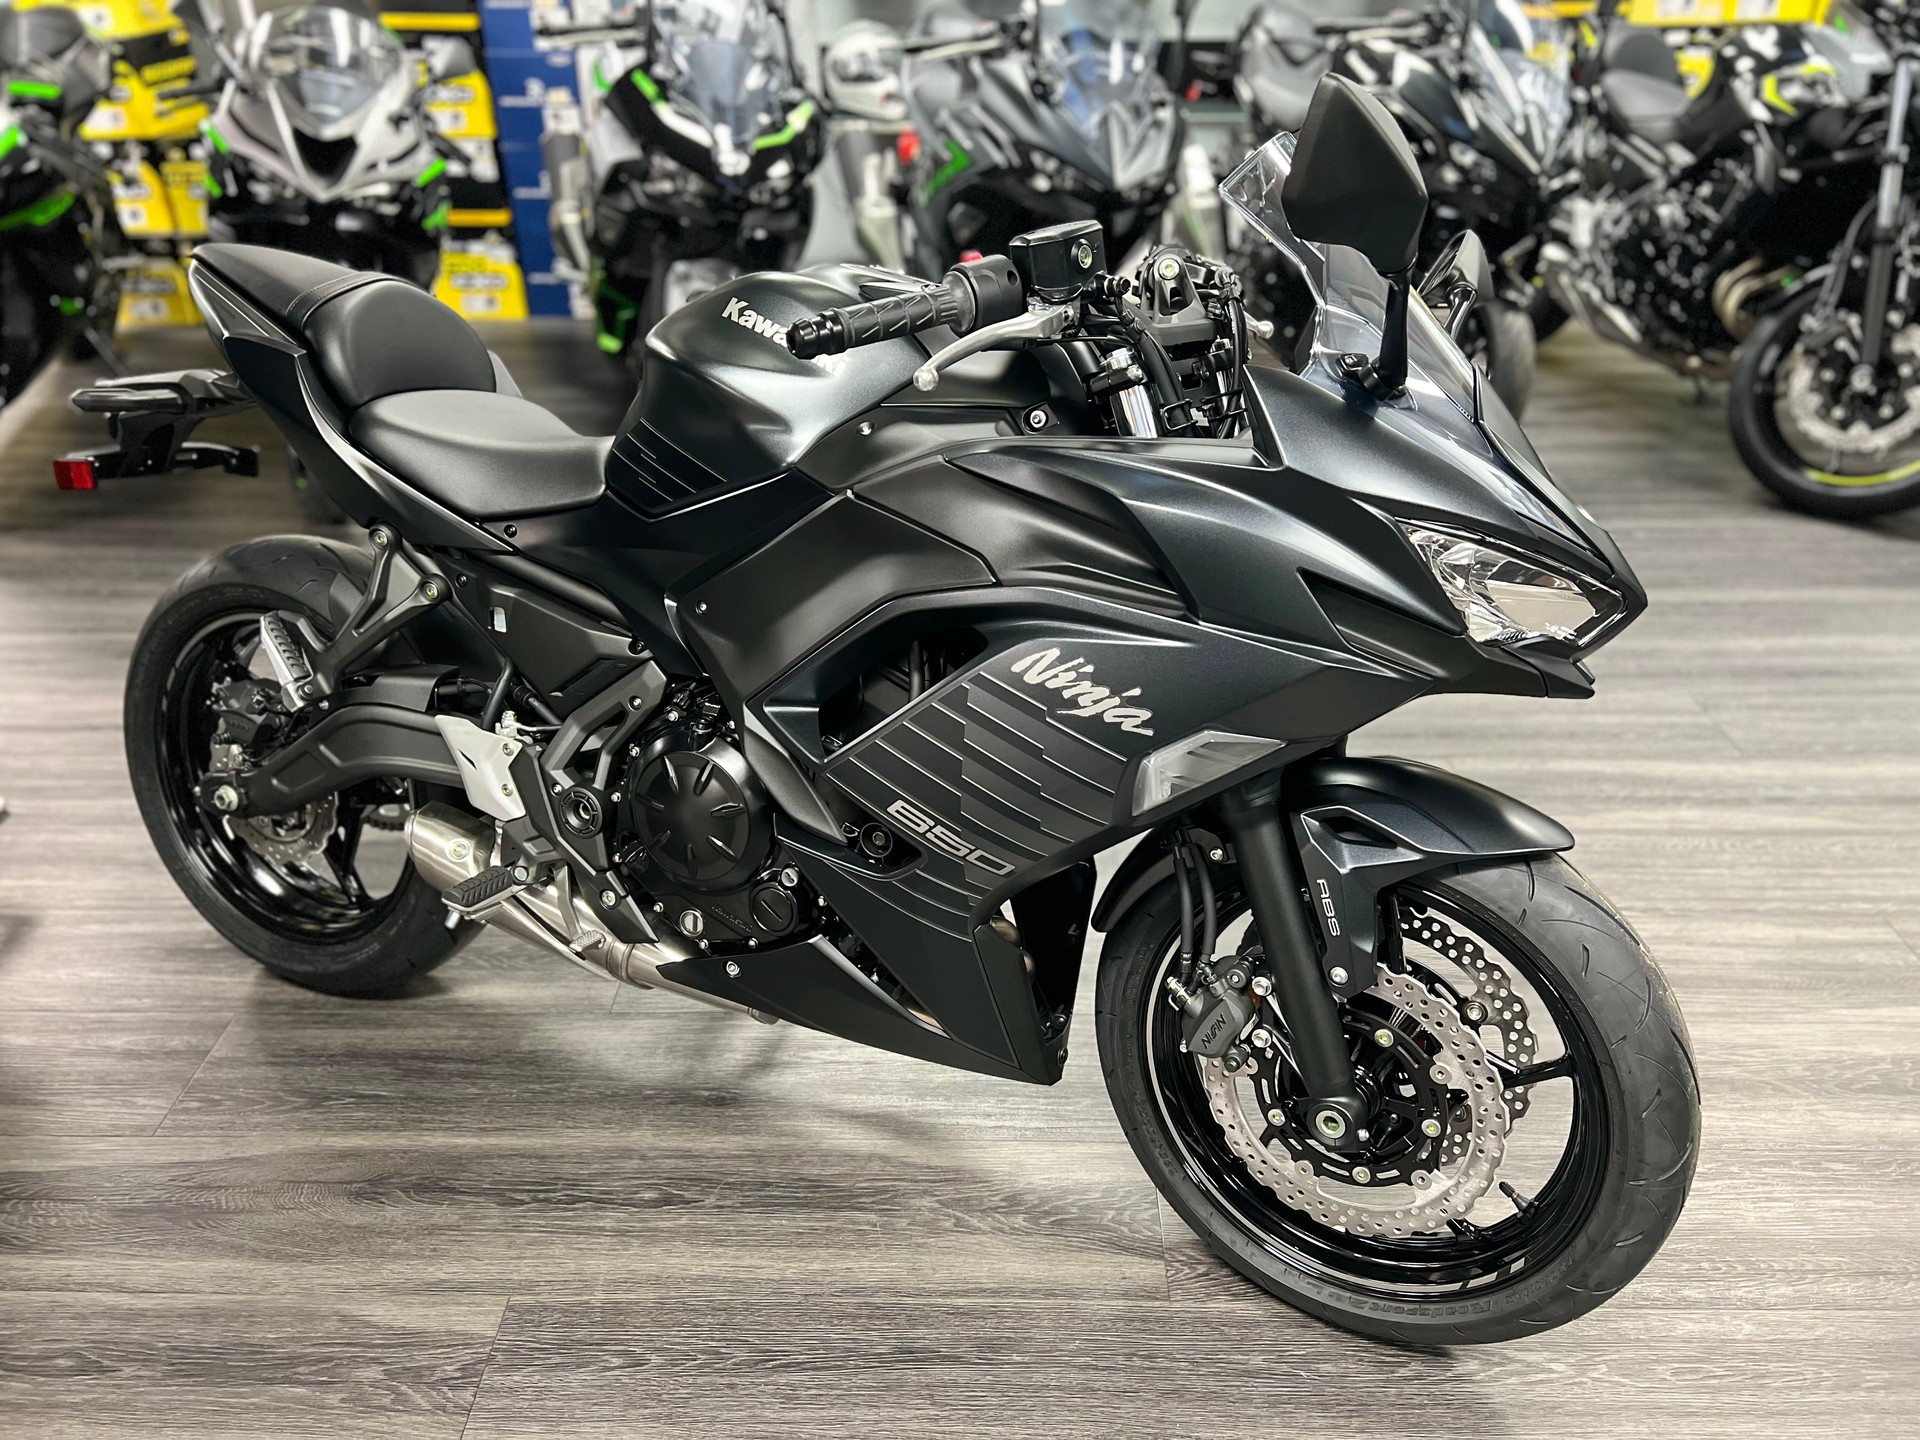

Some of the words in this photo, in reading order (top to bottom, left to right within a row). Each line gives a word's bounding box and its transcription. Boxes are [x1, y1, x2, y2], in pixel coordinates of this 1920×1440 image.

[1011, 647, 1154, 736] Ninja
[886, 799, 1016, 875] 650
[1317, 878, 1341, 937] ABS
